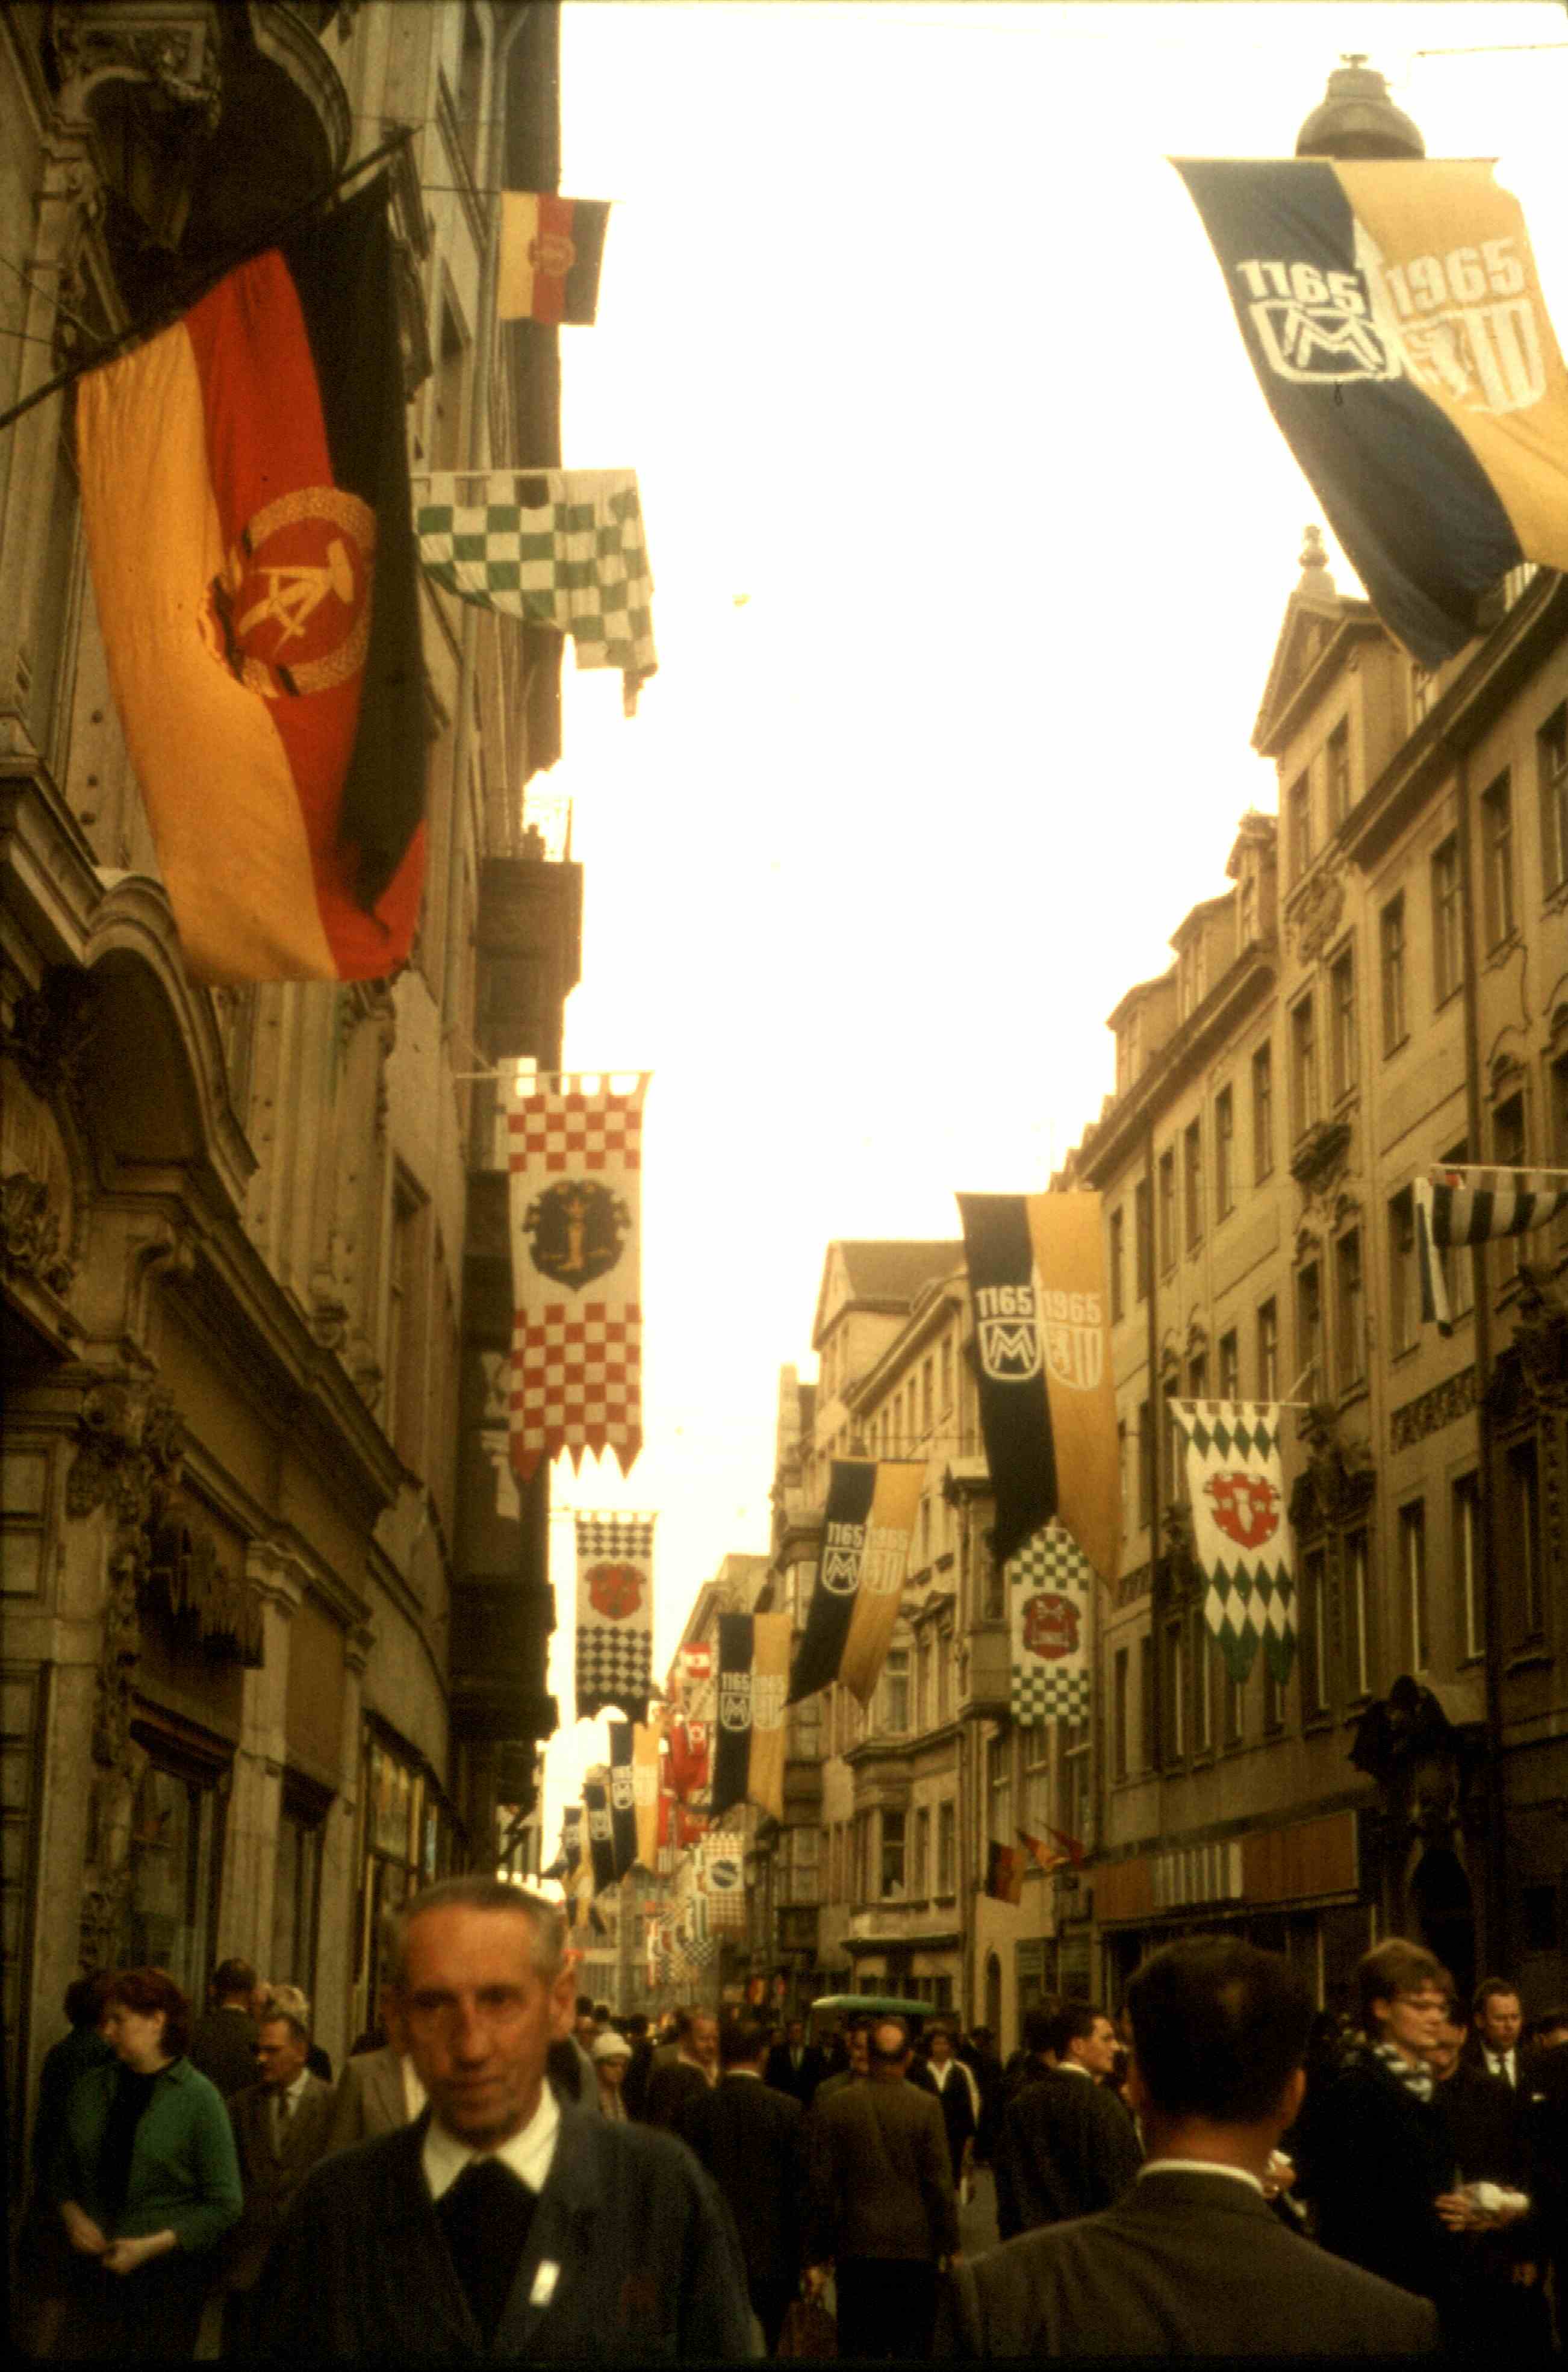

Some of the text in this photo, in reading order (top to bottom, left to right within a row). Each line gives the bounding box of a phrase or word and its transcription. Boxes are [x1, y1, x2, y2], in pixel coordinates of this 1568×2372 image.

[1236, 239, 1525, 317] 1165 1965
[975, 1286, 1101, 1324] 1165 1965
[827, 1522, 863, 1547] 1165
